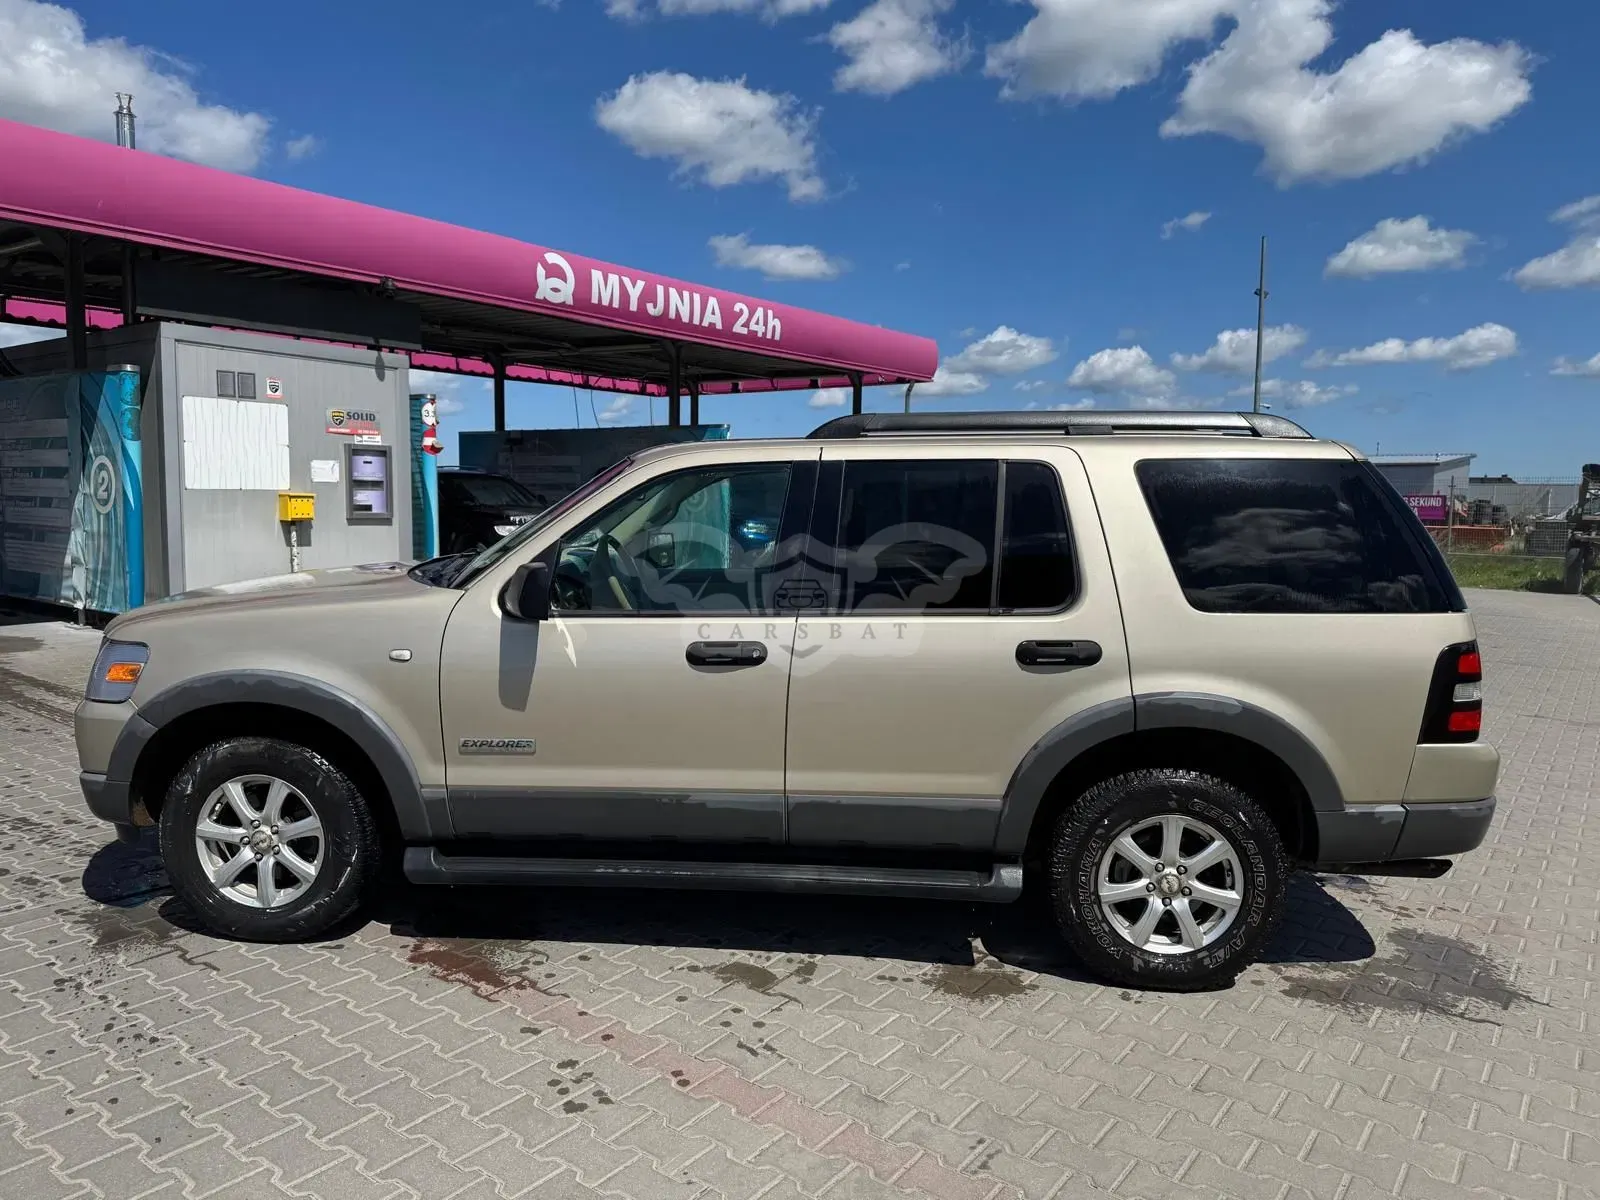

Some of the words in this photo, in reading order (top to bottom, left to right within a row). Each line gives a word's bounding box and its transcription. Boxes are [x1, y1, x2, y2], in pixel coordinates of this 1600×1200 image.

[590, 268, 723, 330] MYJNIA
[732, 301, 782, 341] 24h
[346, 411, 376, 422] SOLID
[97, 470, 110, 500] 2
[1409, 497, 1442, 507] SEKUND
[461, 739, 533, 749] EXPLORER
[1188, 799, 1266, 927] GEOLANDAR
[1077, 837, 1124, 960] YOKOHAMA
